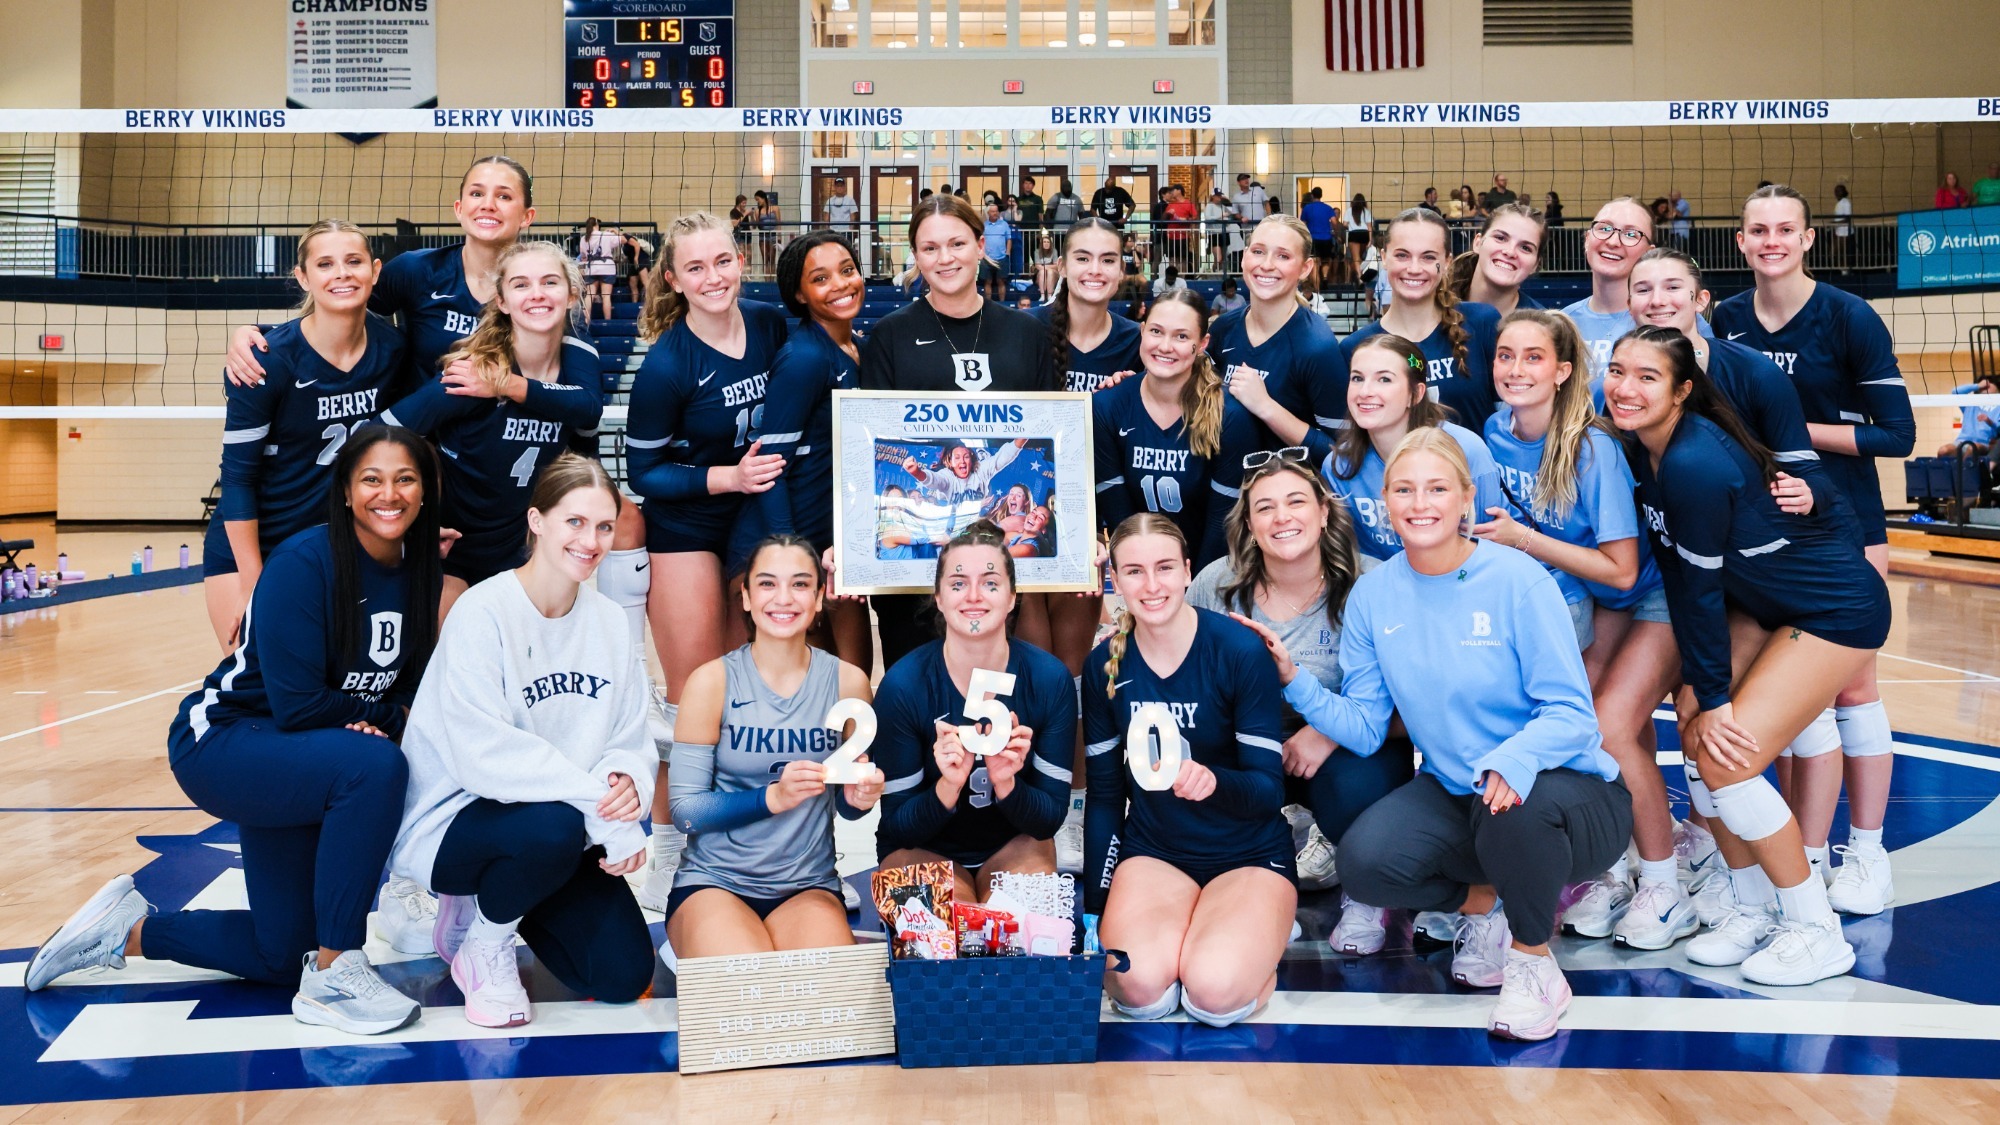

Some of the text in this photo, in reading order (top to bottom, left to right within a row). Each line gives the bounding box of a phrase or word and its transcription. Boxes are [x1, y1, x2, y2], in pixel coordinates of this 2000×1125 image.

[292, 0, 428, 13] CHAMPIONS
[612, 3, 686, 12] SCOREBOARD
[640, 20, 680, 42] 1:15
[578, 46, 606, 56] HOME
[690, 46, 721, 56] GUEST
[596, 58, 611, 80] 0
[644, 60, 656, 78] 3
[708, 58, 724, 80] 0
[580, 90, 593, 107] 2
[712, 89, 724, 106] 0
[126, 110, 286, 128] BERRY VIKINGS
[434, 110, 594, 127] BERRY VIKINGS
[743, 108, 903, 126] BERRY VIKINGS
[1052, 106, 1211, 124] BERRY VIKINGS
[1360, 104, 1520, 122] BERRY VIKINGS
[1670, 101, 1829, 119] BERRY VIKINGS
[1940, 234, 2000, 249] Atrium
[1922, 274, 1948, 282] Official
[963, 358, 982, 380] B
[318, 388, 378, 420] BERRY
[904, 404, 949, 423] 250
[957, 404, 1024, 423] WINS
[502, 418, 562, 443] BERRY
[946, 424, 994, 433] MORIARTY
[1003, 424, 1025, 433] 2026
[510, 447, 540, 487] 4
[1132, 446, 1188, 472] BERRY
[1140, 475, 1184, 513] 10
[1472, 612, 1491, 636] B
[378, 620, 395, 652] B
[1318, 630, 1331, 646] B
[522, 672, 611, 709] BERRY
[958, 668, 1016, 756] 5
[729, 725, 838, 753] VIKINGS
[823, 698, 878, 784] 2
[1127, 704, 1182, 791] 0
[969, 767, 992, 809] 9
[726, 951, 830, 972] 250 WINS
[741, 981, 819, 1002] IN THE
[719, 1008, 857, 1034] BIG DOG ERA
[712, 1046, 752, 1065] AND
